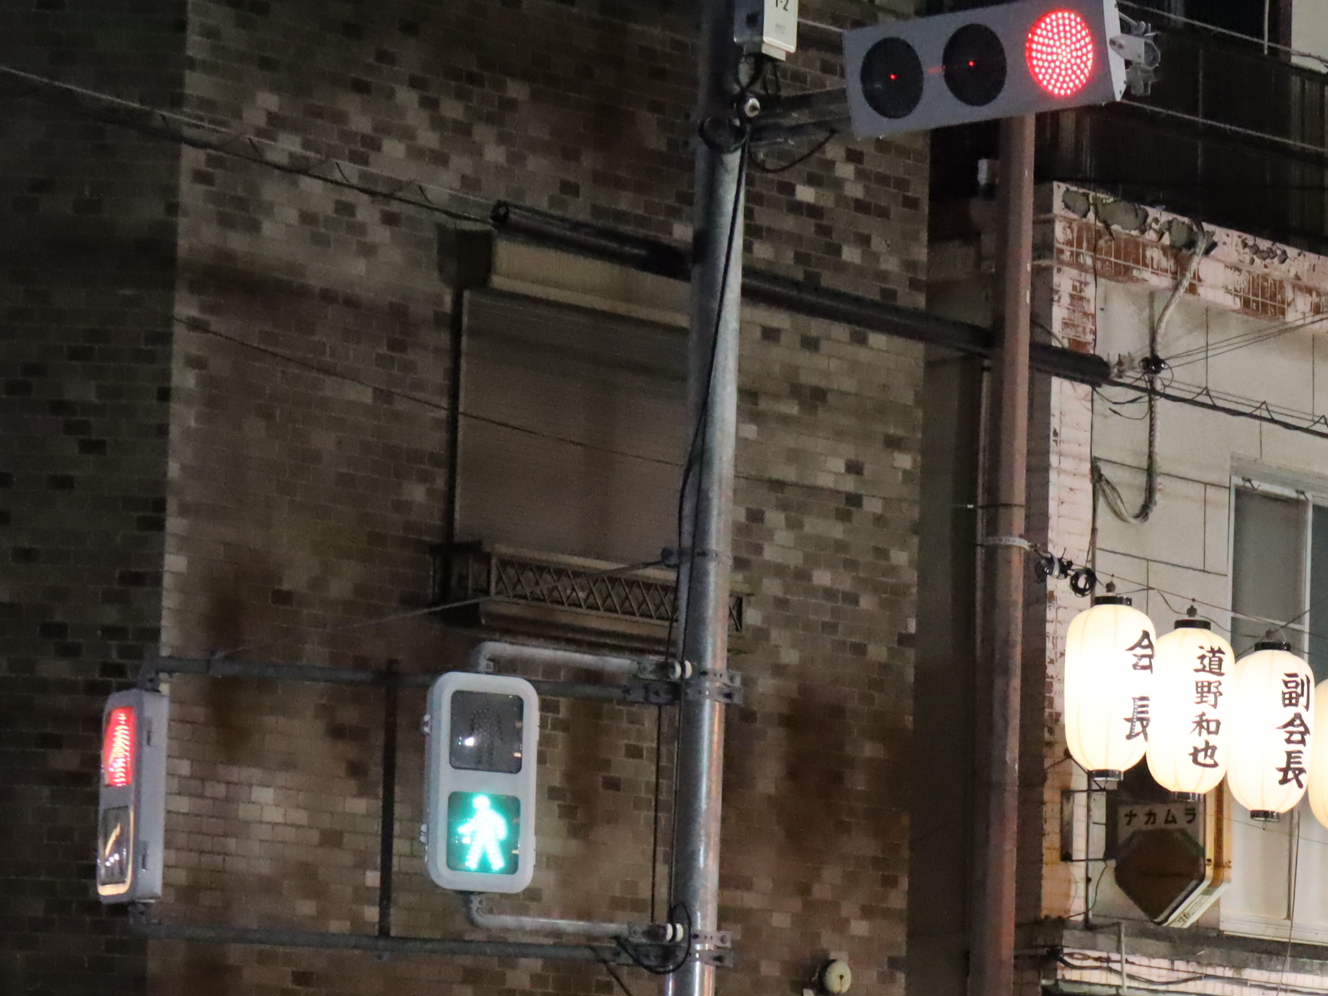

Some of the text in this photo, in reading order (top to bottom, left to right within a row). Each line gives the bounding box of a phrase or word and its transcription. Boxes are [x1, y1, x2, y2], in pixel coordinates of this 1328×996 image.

[1123, 630, 1155, 741] 会長
[1188, 645, 1226, 769] 道野和也
[1276, 672, 1311, 789] 副会長
[1123, 807, 1197, 826] ナカムラ
